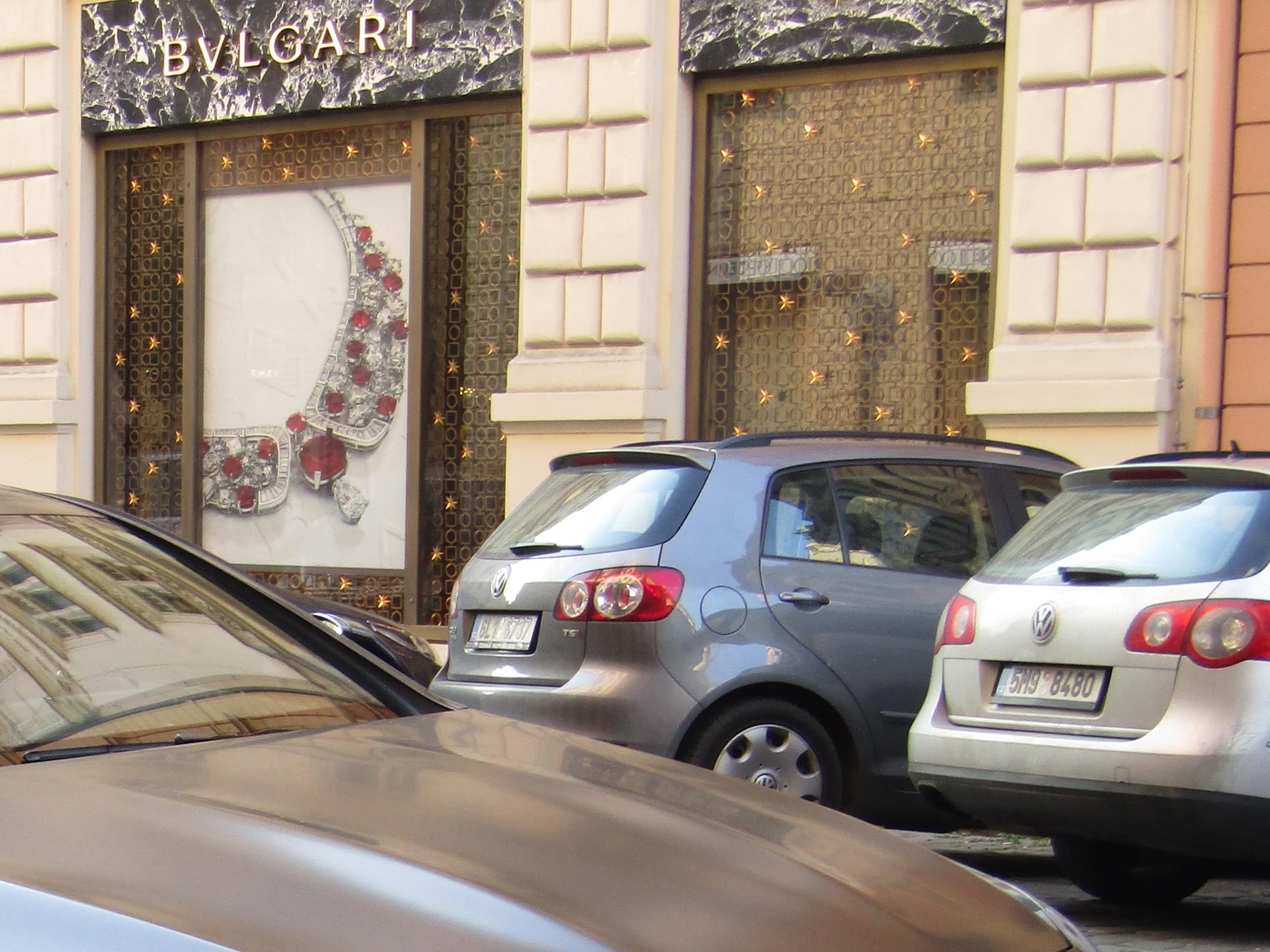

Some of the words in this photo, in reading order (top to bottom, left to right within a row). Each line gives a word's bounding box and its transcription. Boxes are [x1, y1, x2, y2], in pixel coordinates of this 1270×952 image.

[163, 10, 417, 77] BVLGARI
[1009, 668, 1041, 695] 5M9
[1050, 670, 1096, 698] 8480
